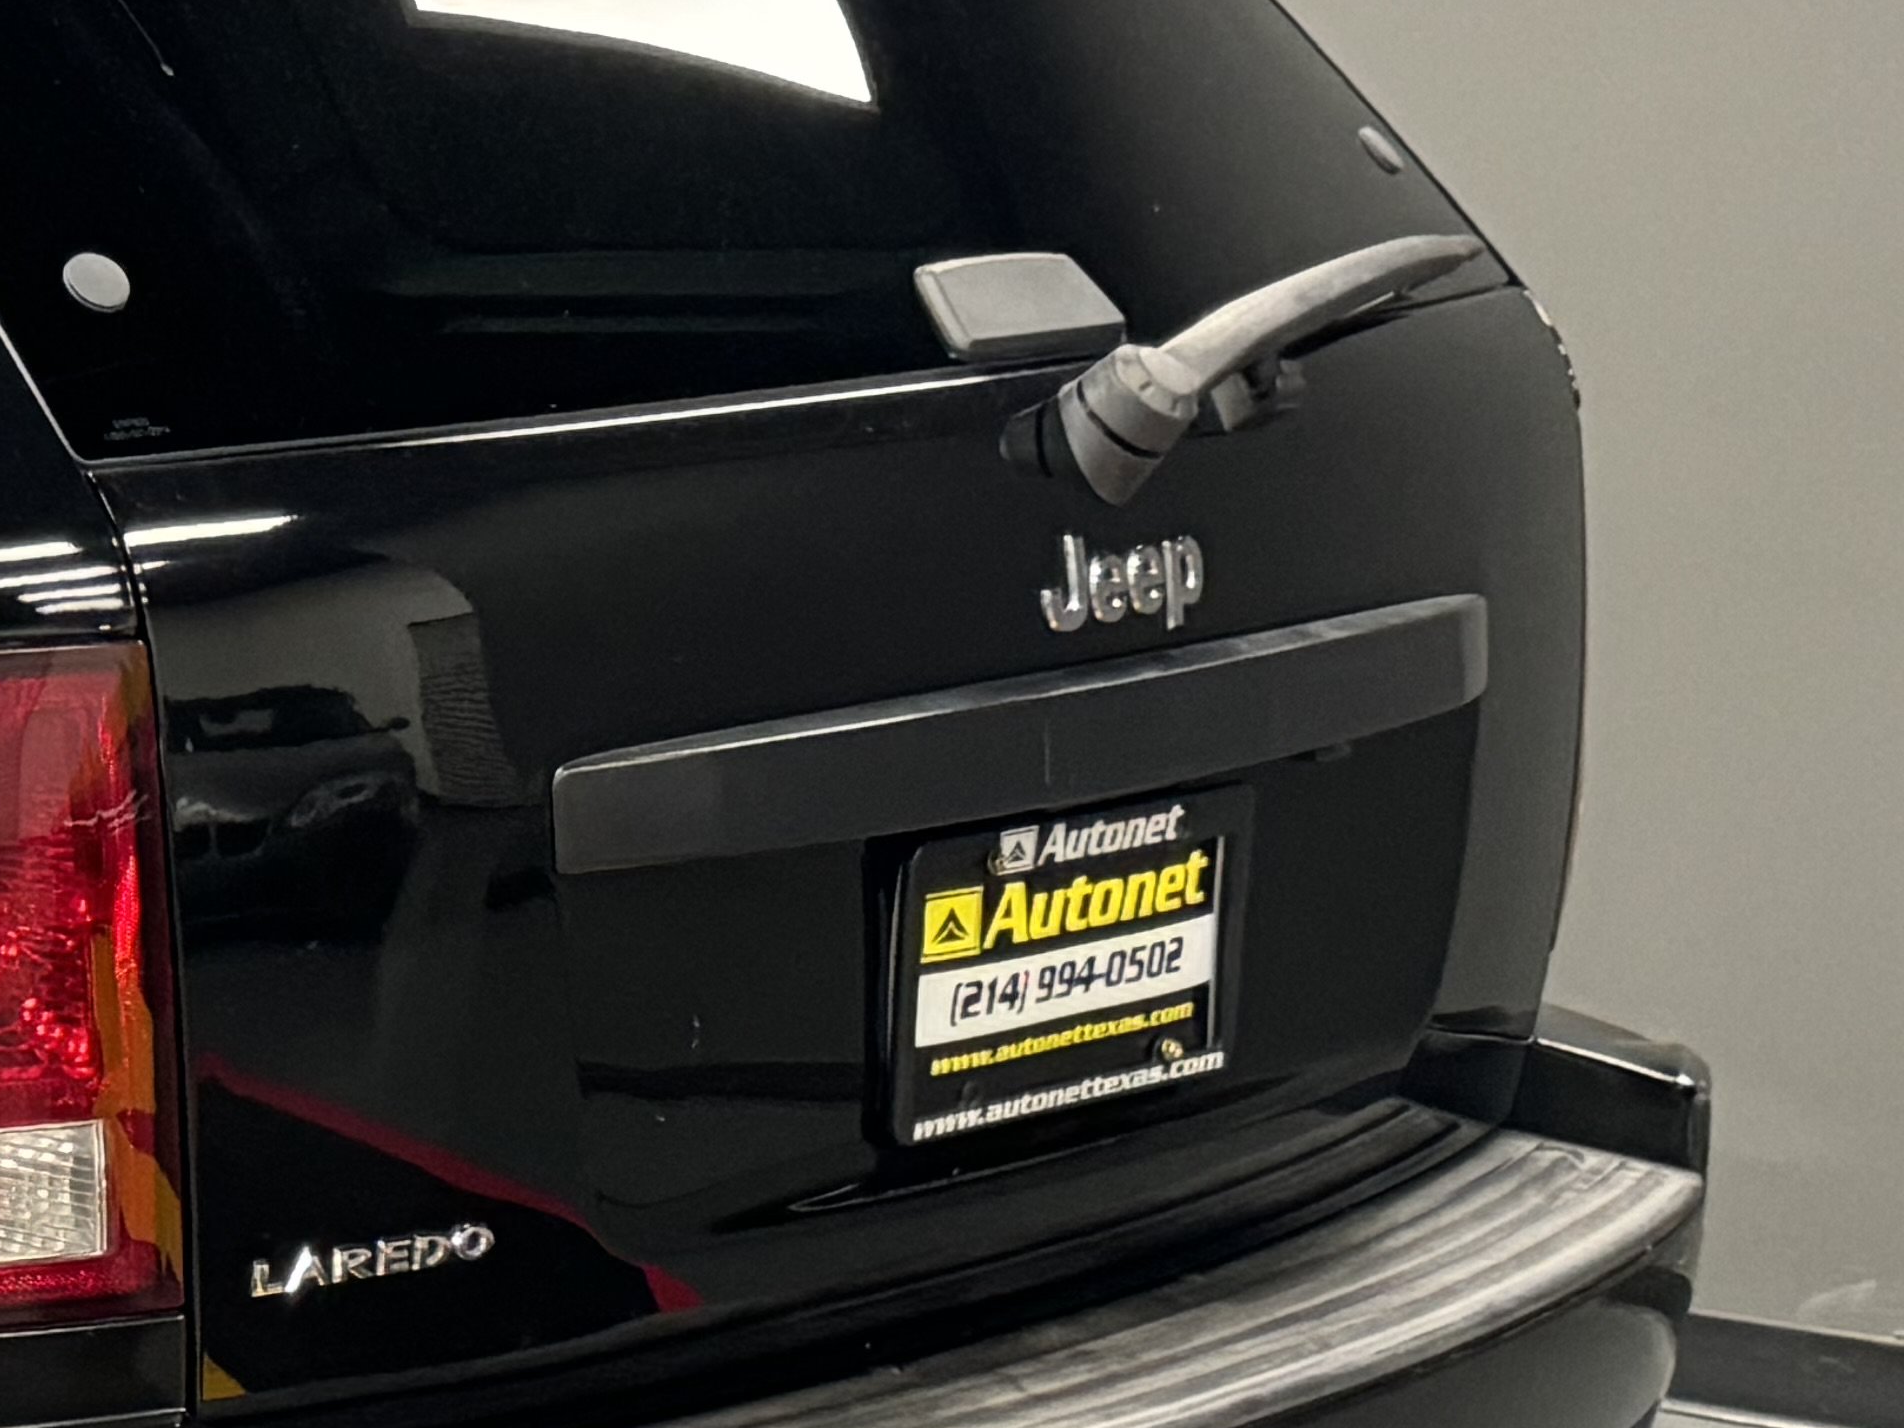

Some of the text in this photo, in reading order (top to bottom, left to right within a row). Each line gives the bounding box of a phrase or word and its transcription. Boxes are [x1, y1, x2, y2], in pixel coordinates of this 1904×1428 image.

[1040, 533, 1204, 632] Jeep
[1037, 804, 1185, 867] Autonet
[983, 849, 1210, 949] Autonet
[949, 936, 1184, 1027] (214) 994-0502
[930, 1001, 1195, 1076] www.autonettexas.com
[912, 1049, 1224, 1142] www.autonettexas.com
[250, 1223, 496, 1298] LAREDO
